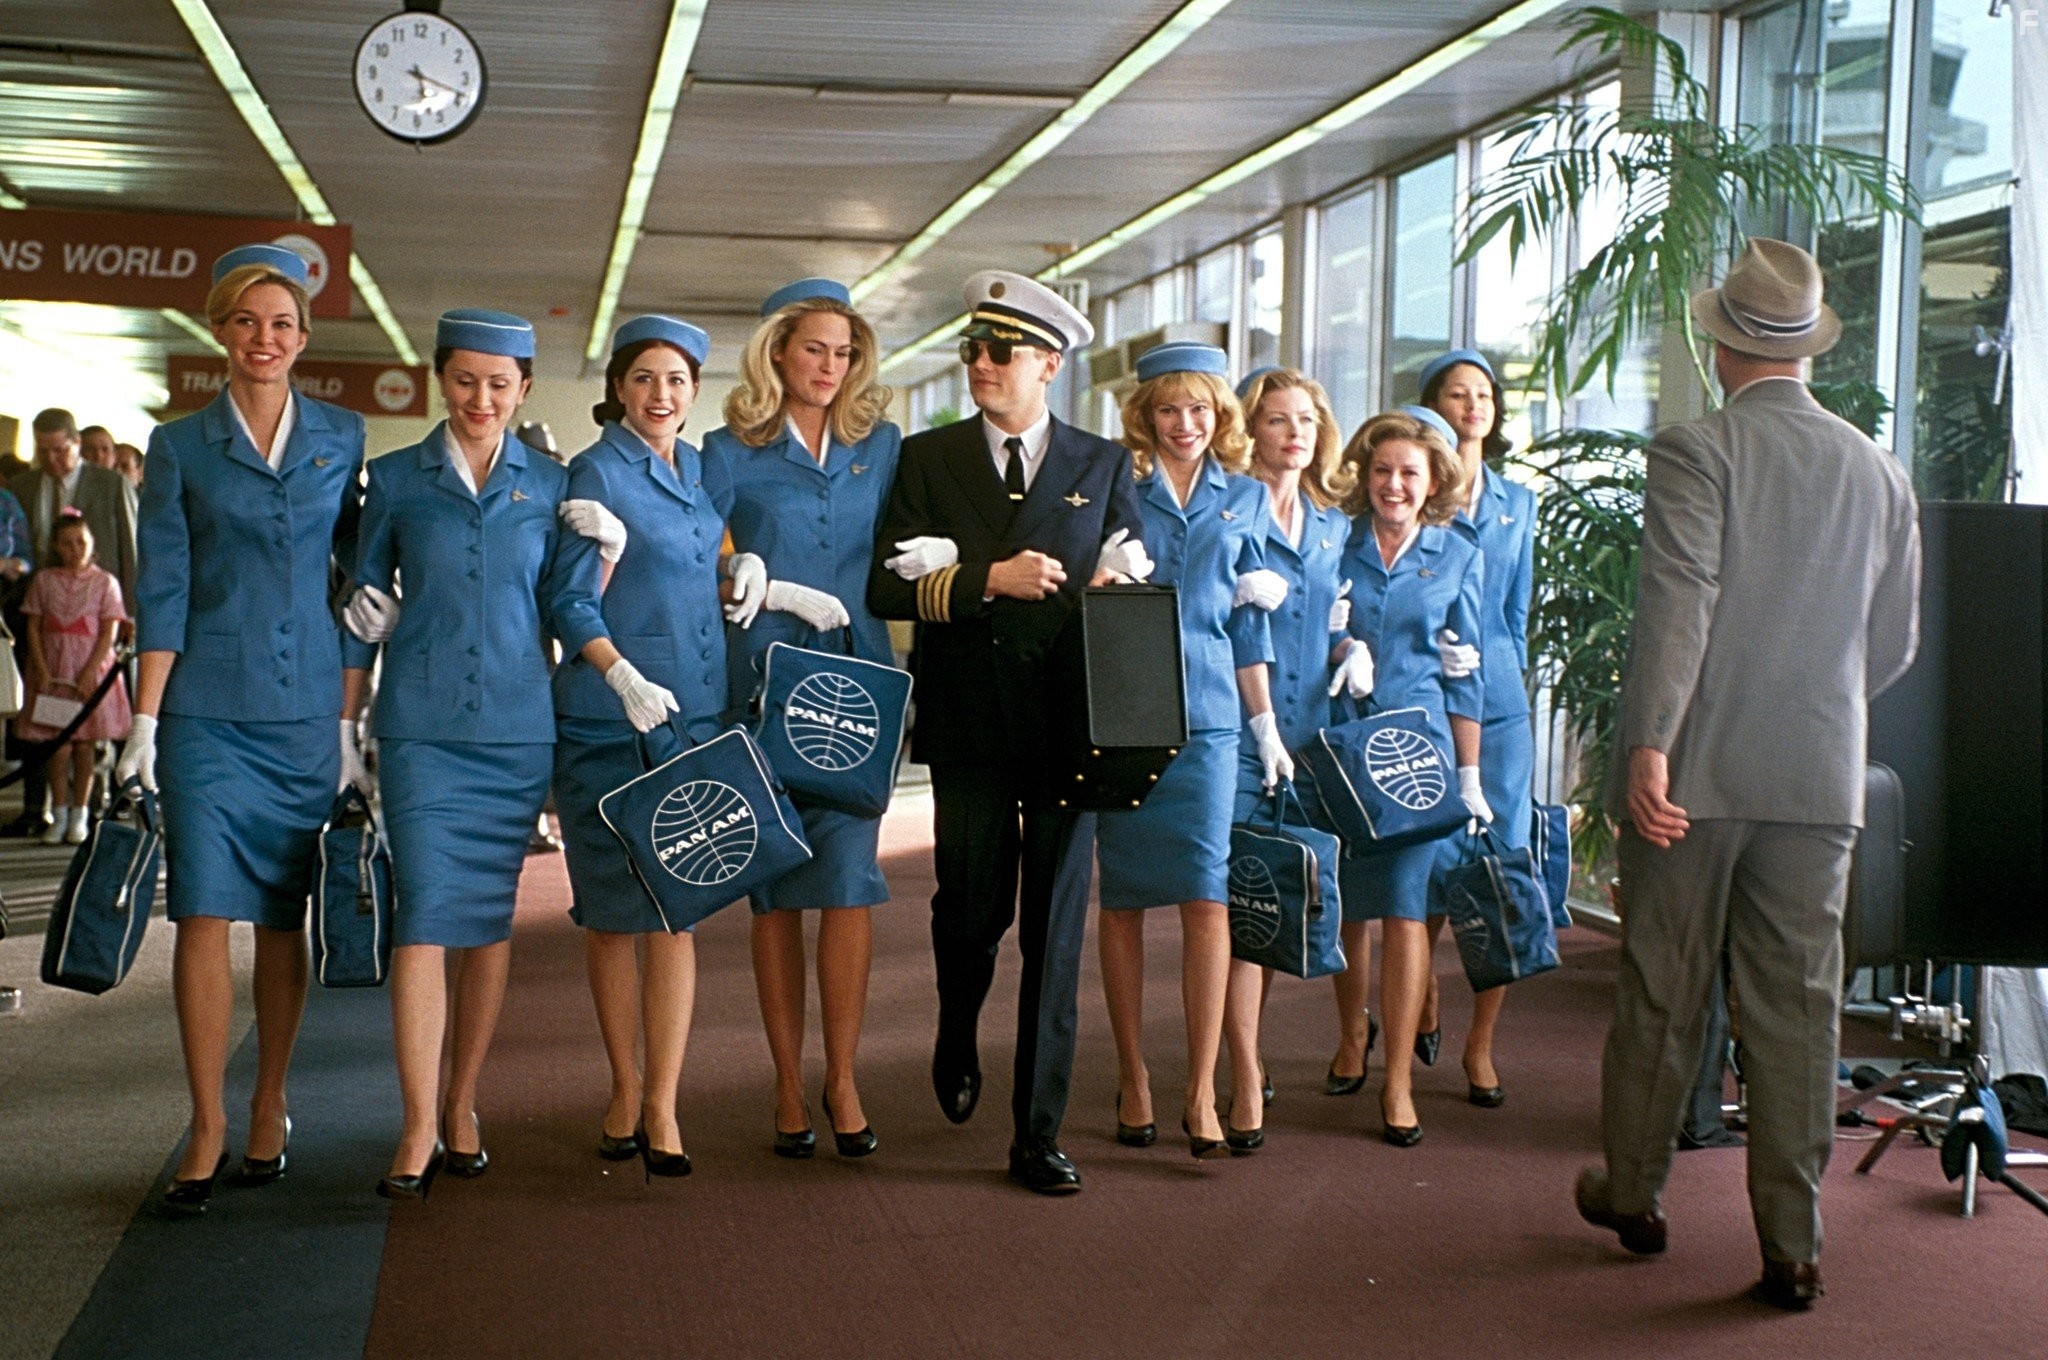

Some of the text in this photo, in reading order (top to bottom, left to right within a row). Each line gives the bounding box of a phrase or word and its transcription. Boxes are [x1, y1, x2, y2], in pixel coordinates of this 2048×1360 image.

[392, 28, 405, 42] 11
[413, 23, 428, 39] 12
[440, 31, 446, 45] 1
[375, 43, 389, 58] 10
[454, 48, 463, 63] 2
[368, 64, 378, 80] 9
[462, 70, 470, 86] 3
[392, 105, 400, 121] 7
[63, 243, 197, 279] WORLD
[787, 706, 877, 738] PAN AM
[1372, 756, 1439, 781] PAN AM
[659, 806, 750, 862] PAN AM
[1230, 894, 1279, 915] AN AM
